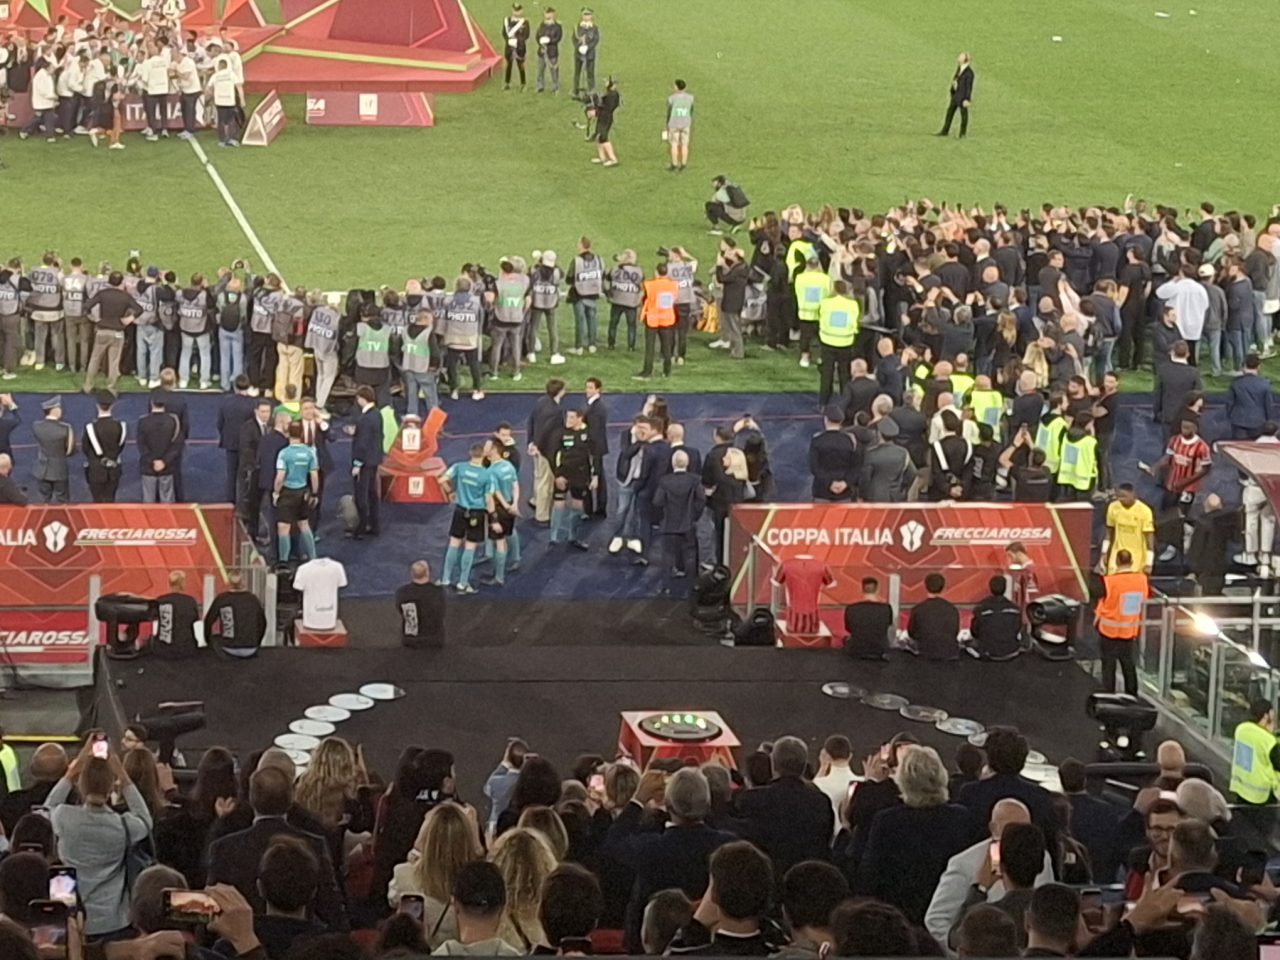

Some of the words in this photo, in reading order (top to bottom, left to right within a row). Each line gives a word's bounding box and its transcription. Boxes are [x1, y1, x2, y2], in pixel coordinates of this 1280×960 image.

[447, 312, 476, 321] PHOTO
[366, 341, 381, 351] TV
[77, 528, 197, 539] FRECCIAROSSA
[768, 528, 830, 545] COPPA
[835, 528, 894, 545] ITALIA
[932, 527, 1052, 539] FRECCIAROSSA
